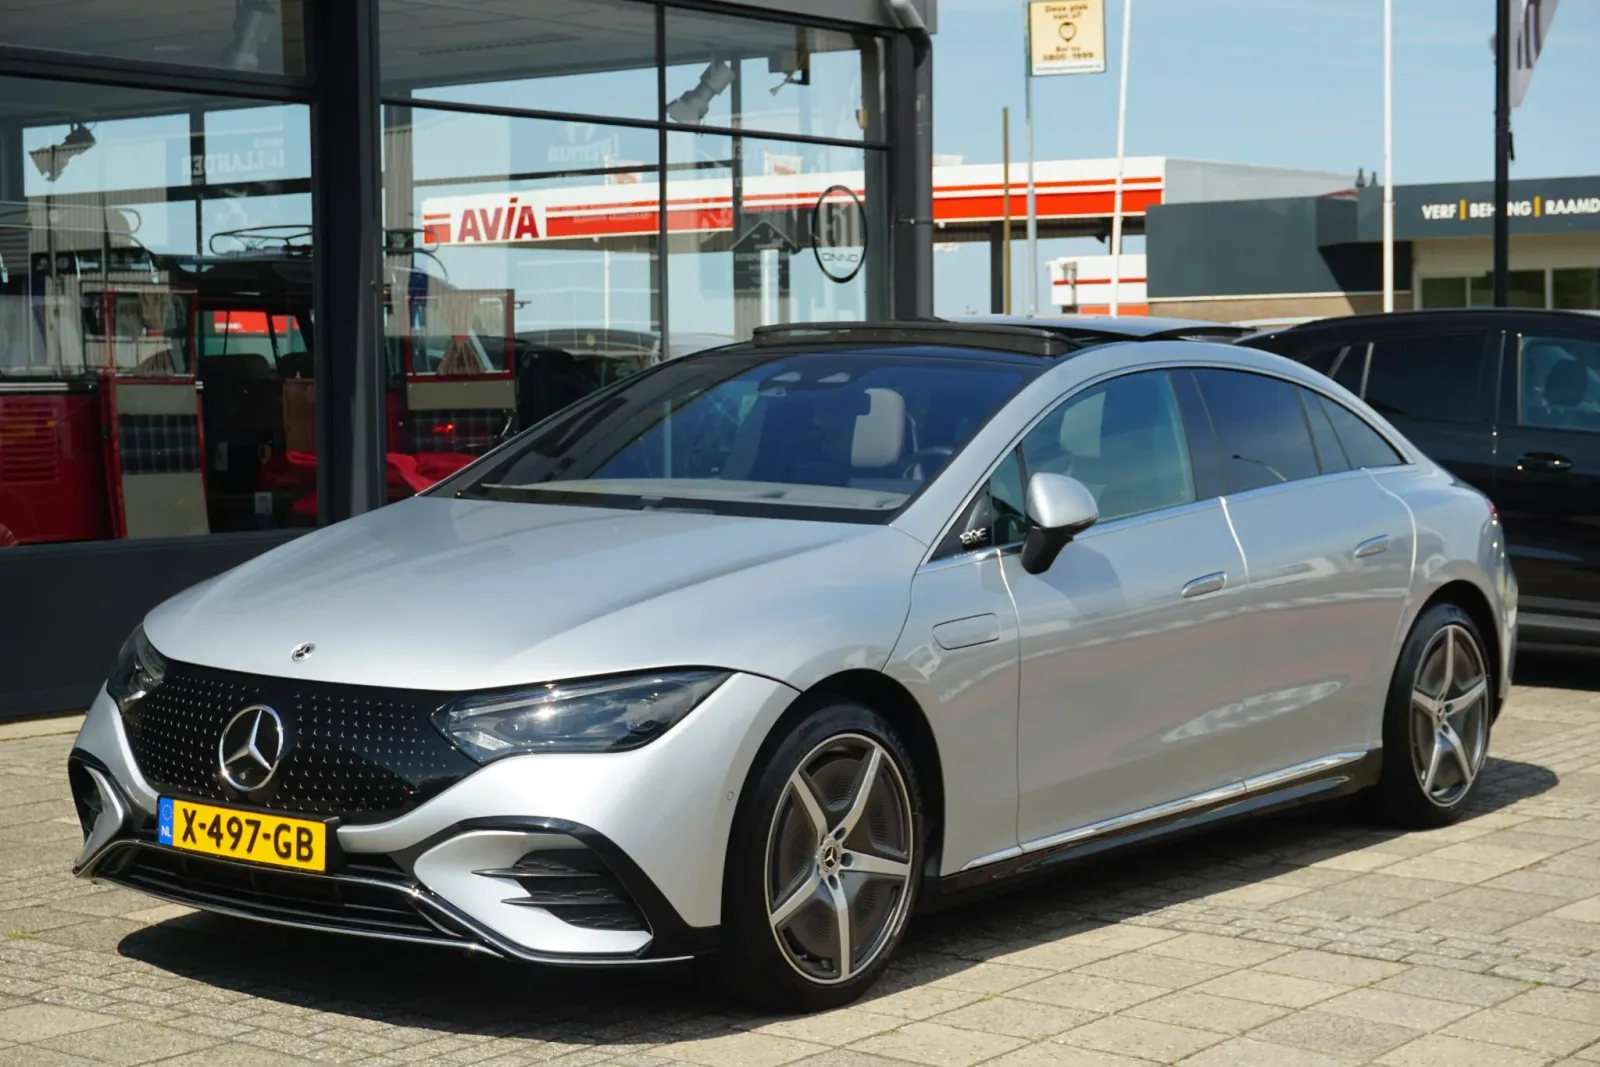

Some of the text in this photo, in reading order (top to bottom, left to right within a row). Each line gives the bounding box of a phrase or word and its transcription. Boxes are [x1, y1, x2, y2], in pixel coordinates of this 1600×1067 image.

[1421, 203, 1457, 220] VERF
[1469, 201, 1532, 218] BEHNG
[161, 825, 172, 838] NL
[182, 808, 314, 863] X-497-GB
